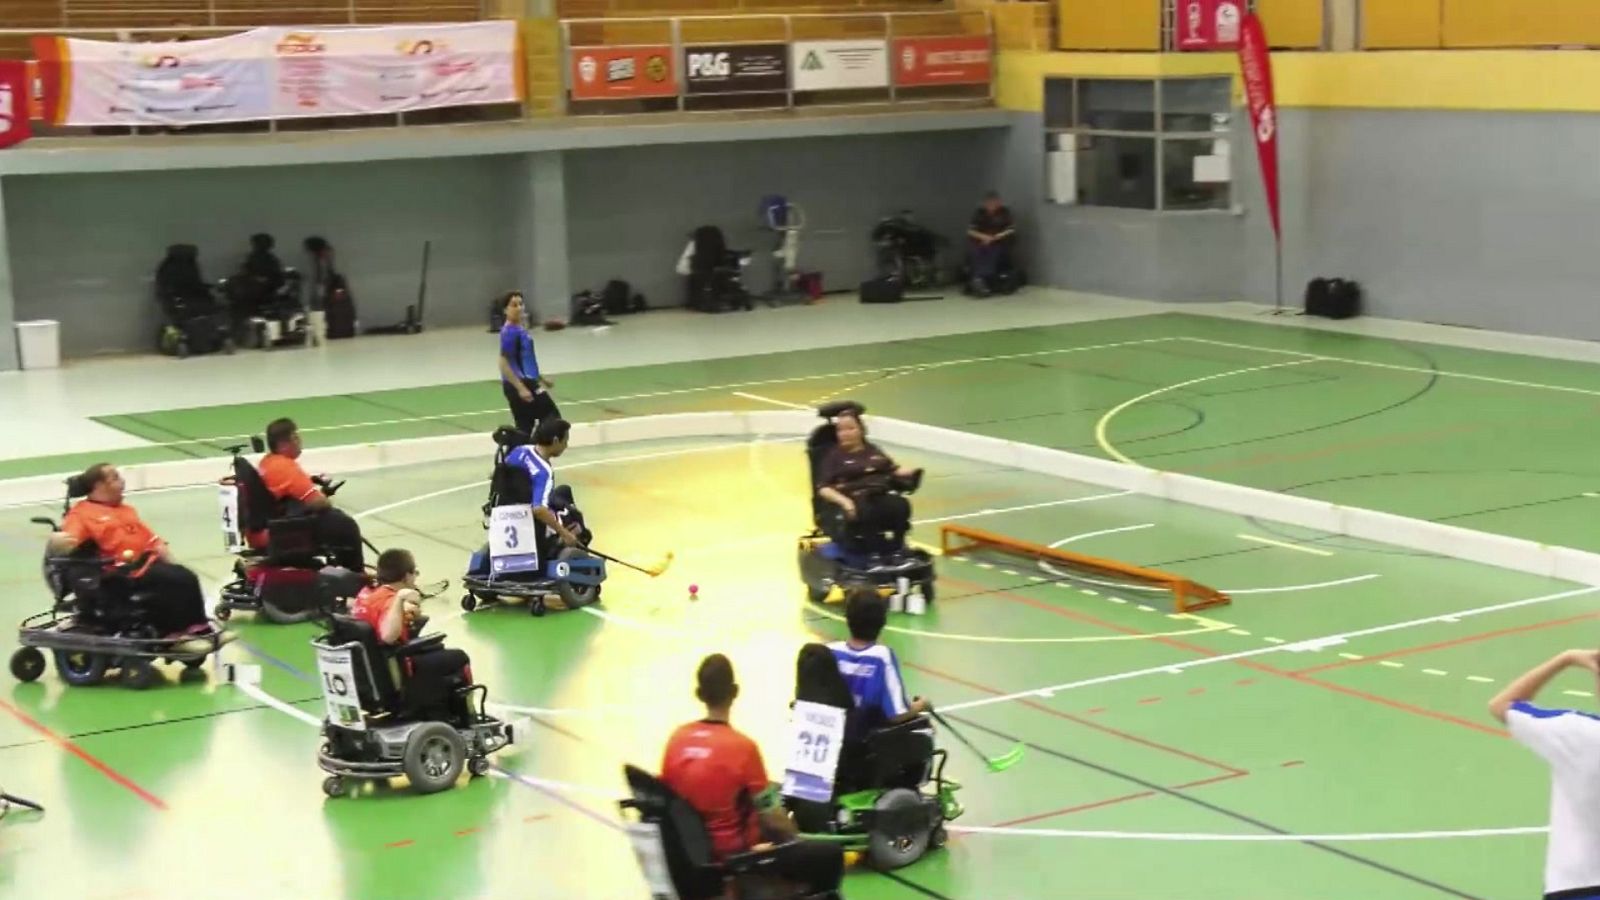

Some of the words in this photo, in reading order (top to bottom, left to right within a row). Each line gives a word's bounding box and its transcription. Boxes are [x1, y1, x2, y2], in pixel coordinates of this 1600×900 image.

[687, 51, 731, 77] P&G
[222, 506, 231, 528] 4
[503, 525, 519, 549] 3
[323, 671, 347, 696] 10
